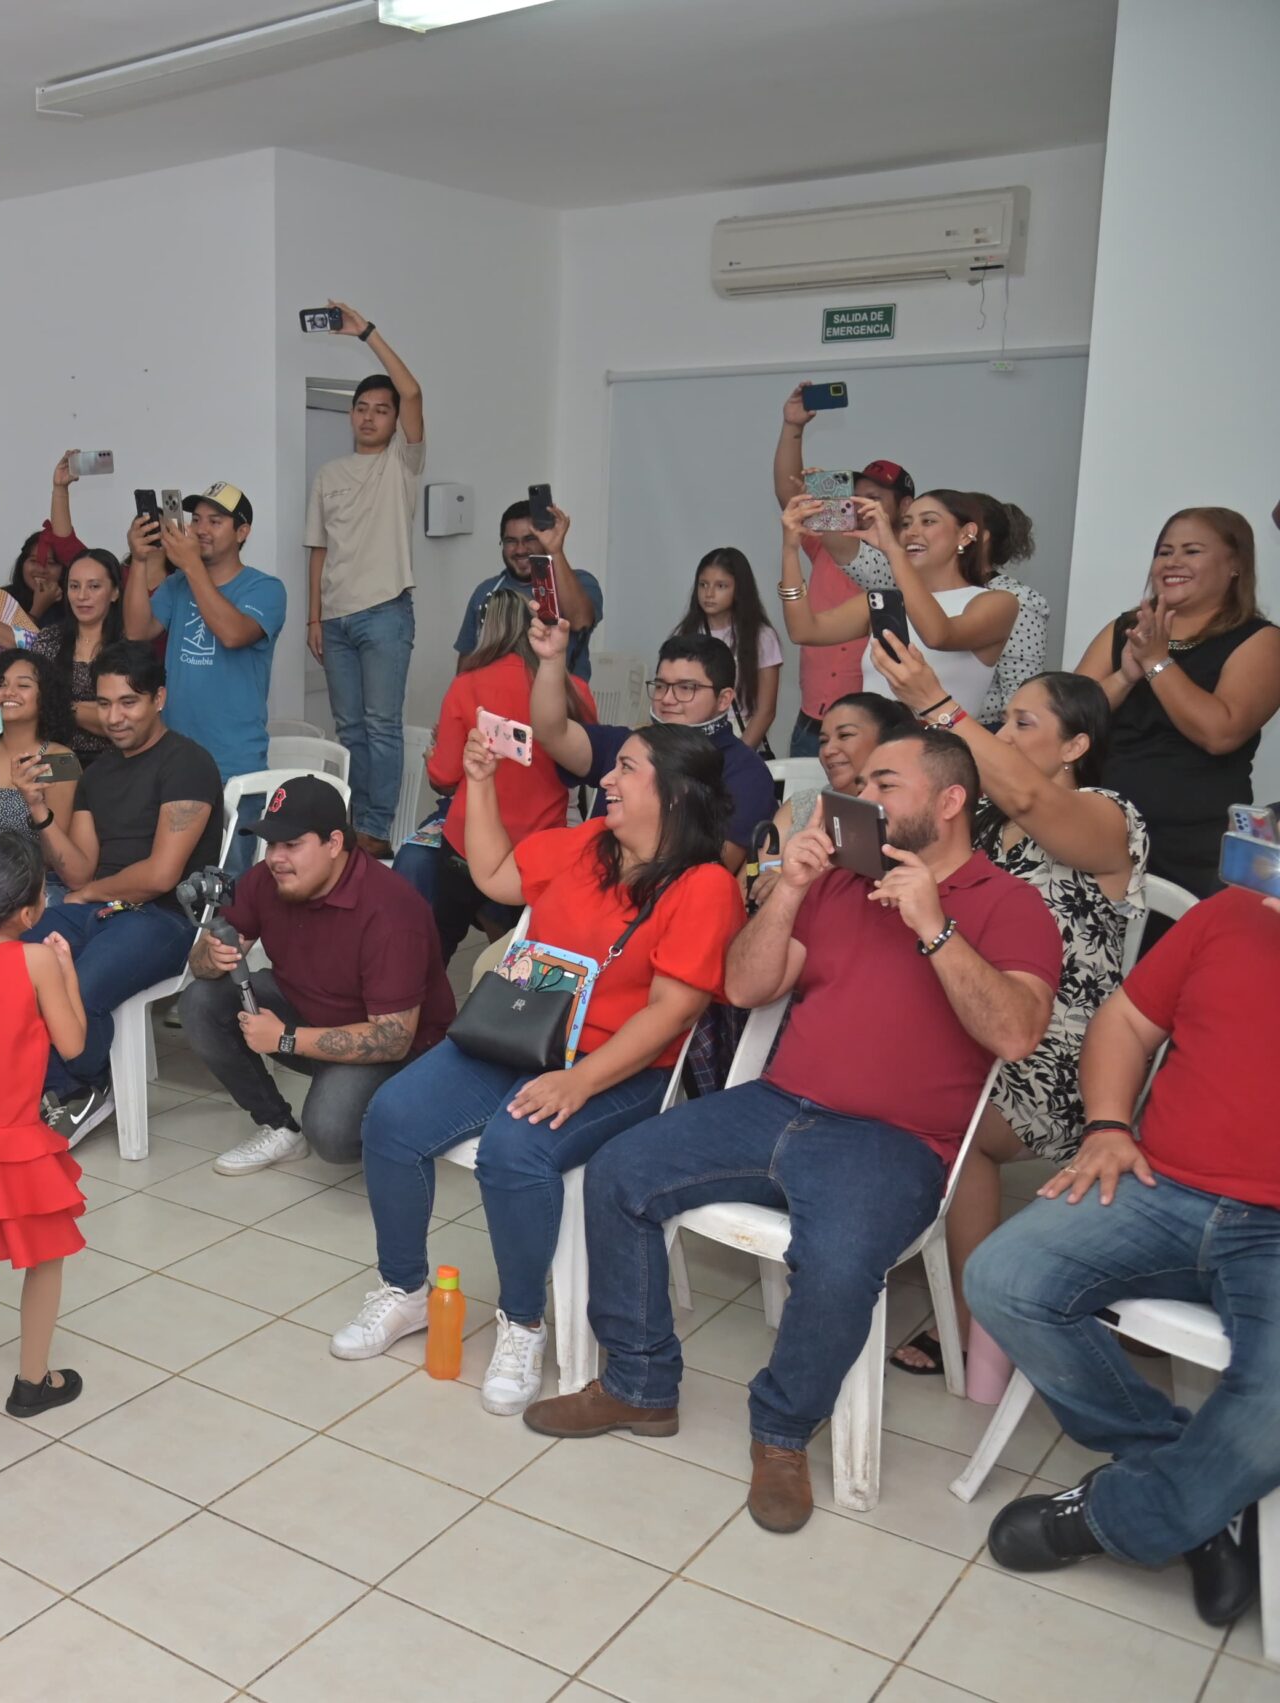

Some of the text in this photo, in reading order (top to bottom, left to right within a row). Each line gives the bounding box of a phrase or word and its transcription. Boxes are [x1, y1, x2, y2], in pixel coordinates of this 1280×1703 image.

[833, 311, 884, 324] SALIDA DE
[826, 323, 890, 337] EMERGENCIA
[179, 654, 214, 666] Columbia
[268, 788, 287, 813] B
